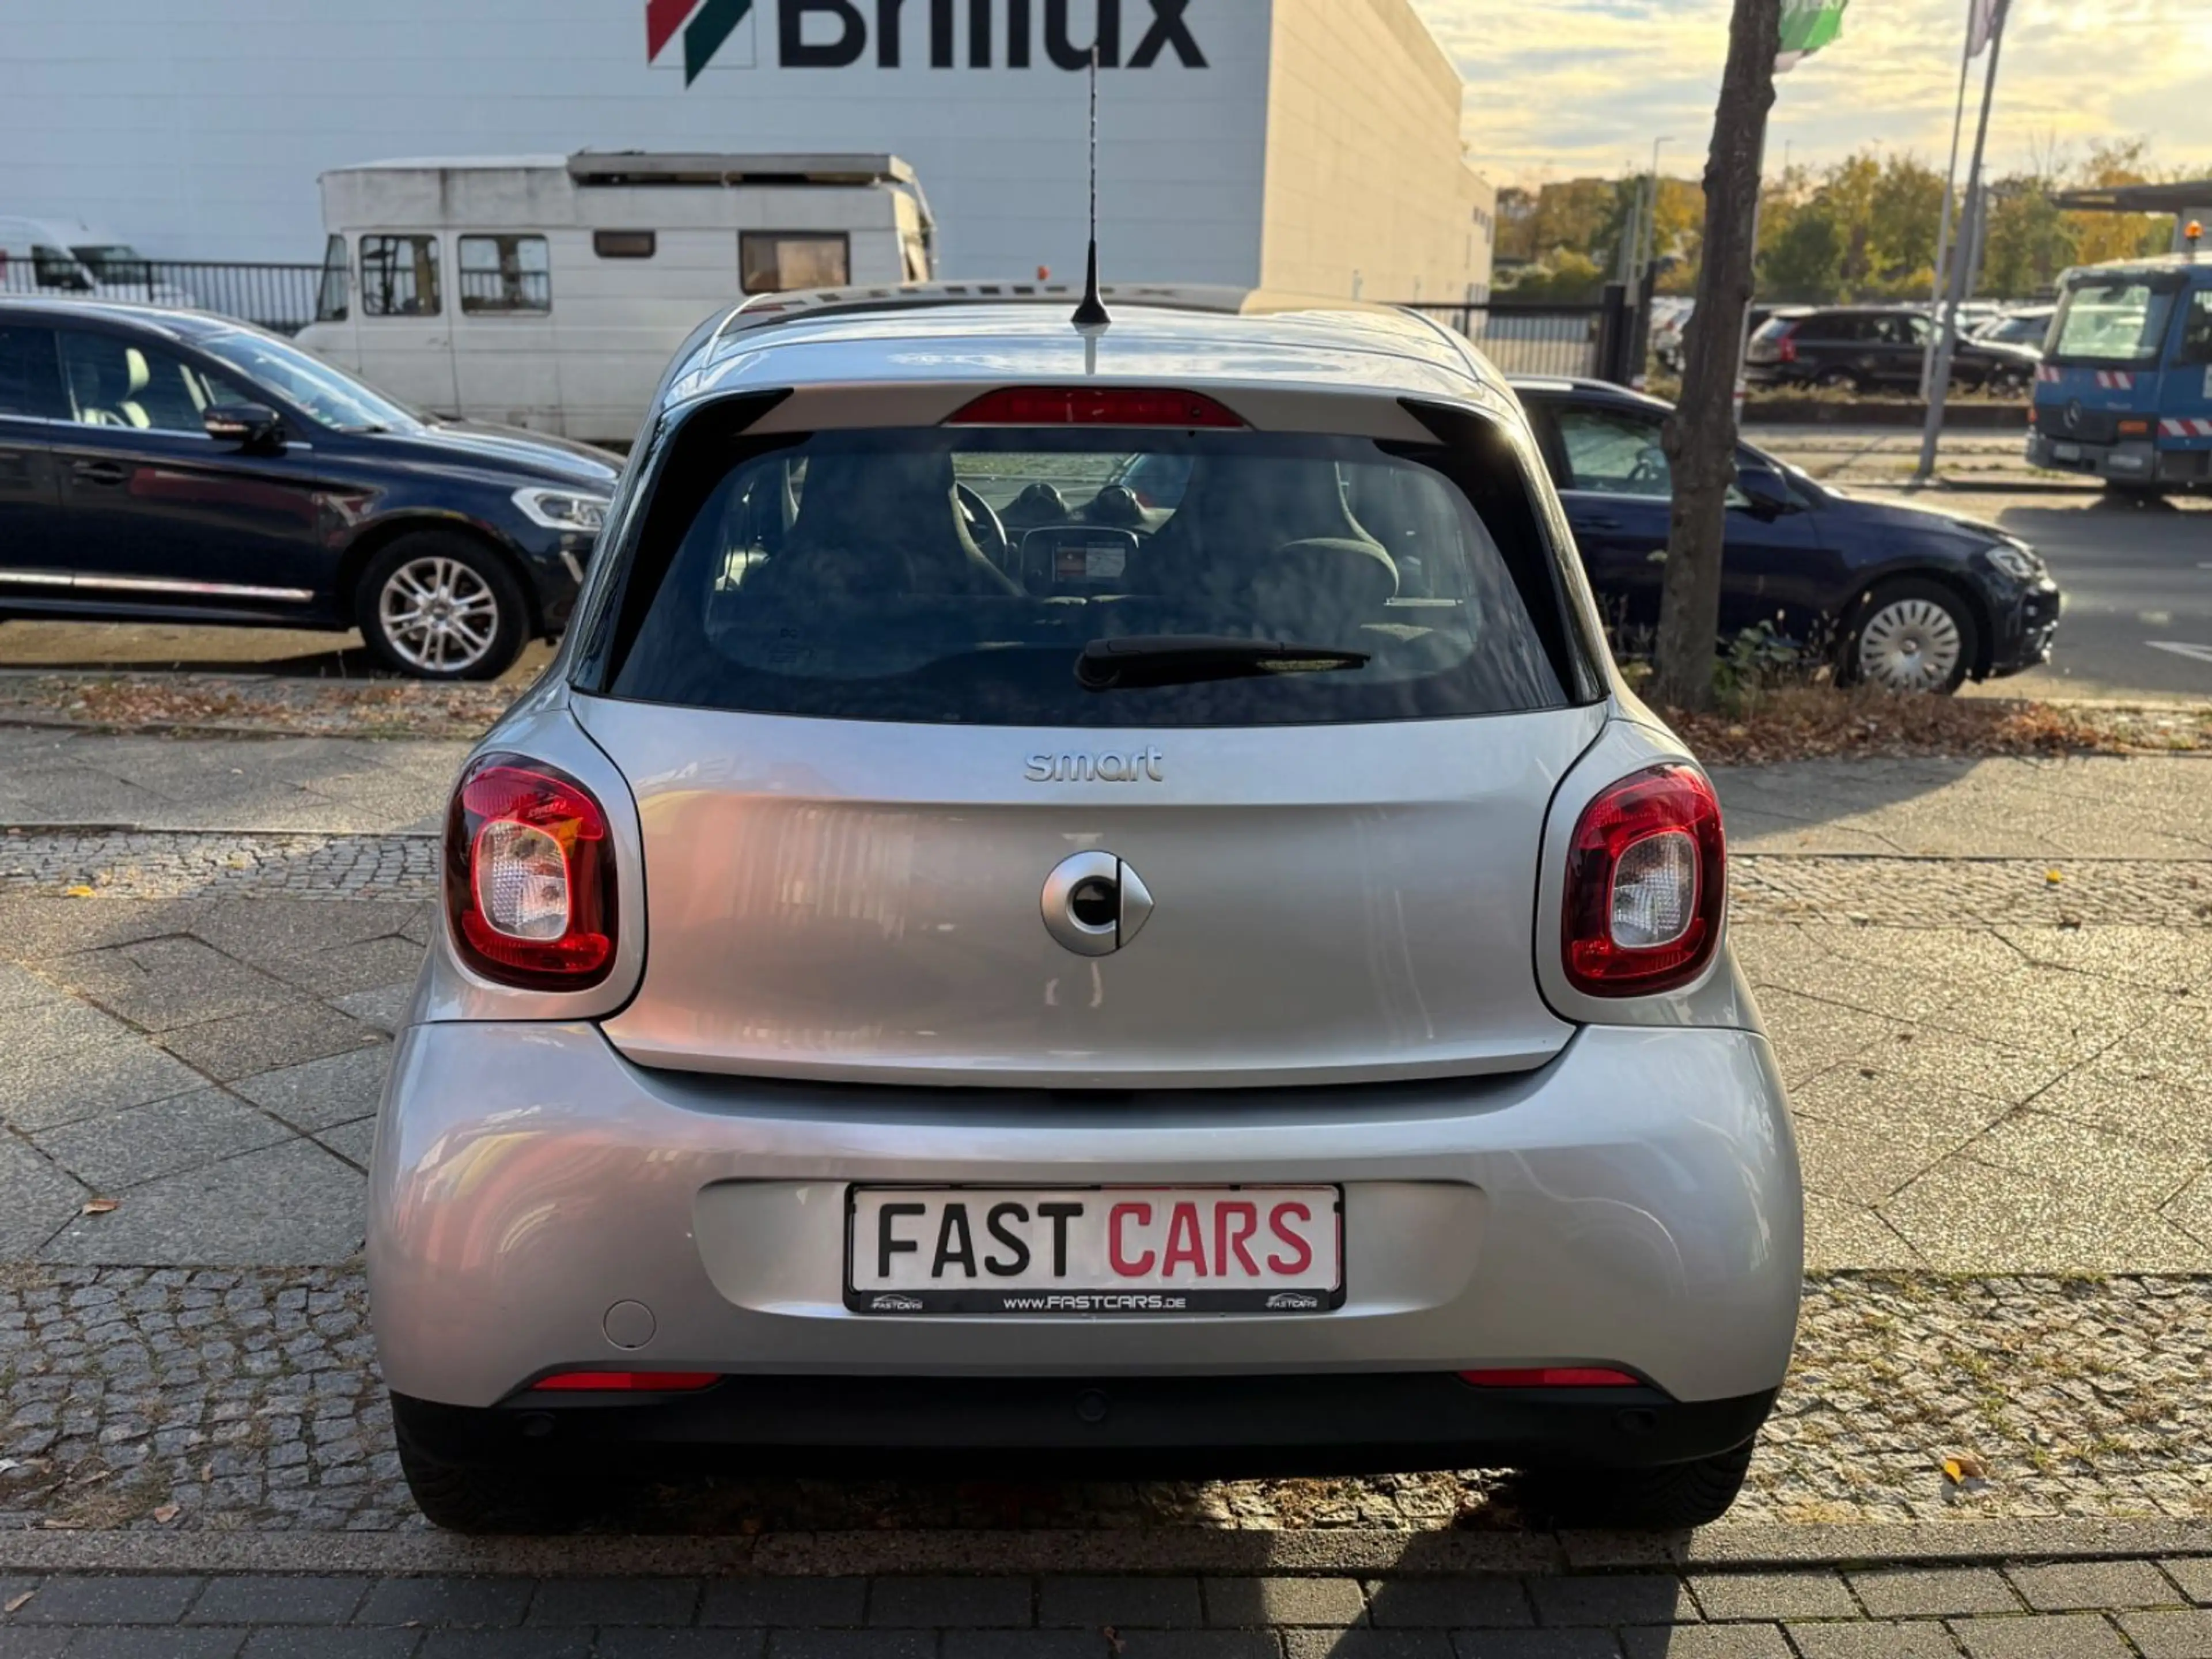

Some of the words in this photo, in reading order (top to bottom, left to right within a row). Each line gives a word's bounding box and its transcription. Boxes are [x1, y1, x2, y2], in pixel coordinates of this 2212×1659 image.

[1024, 744, 1164, 782] smart
[877, 1202, 1084, 1278] FAST
[1108, 1202, 1312, 1277] CARS
